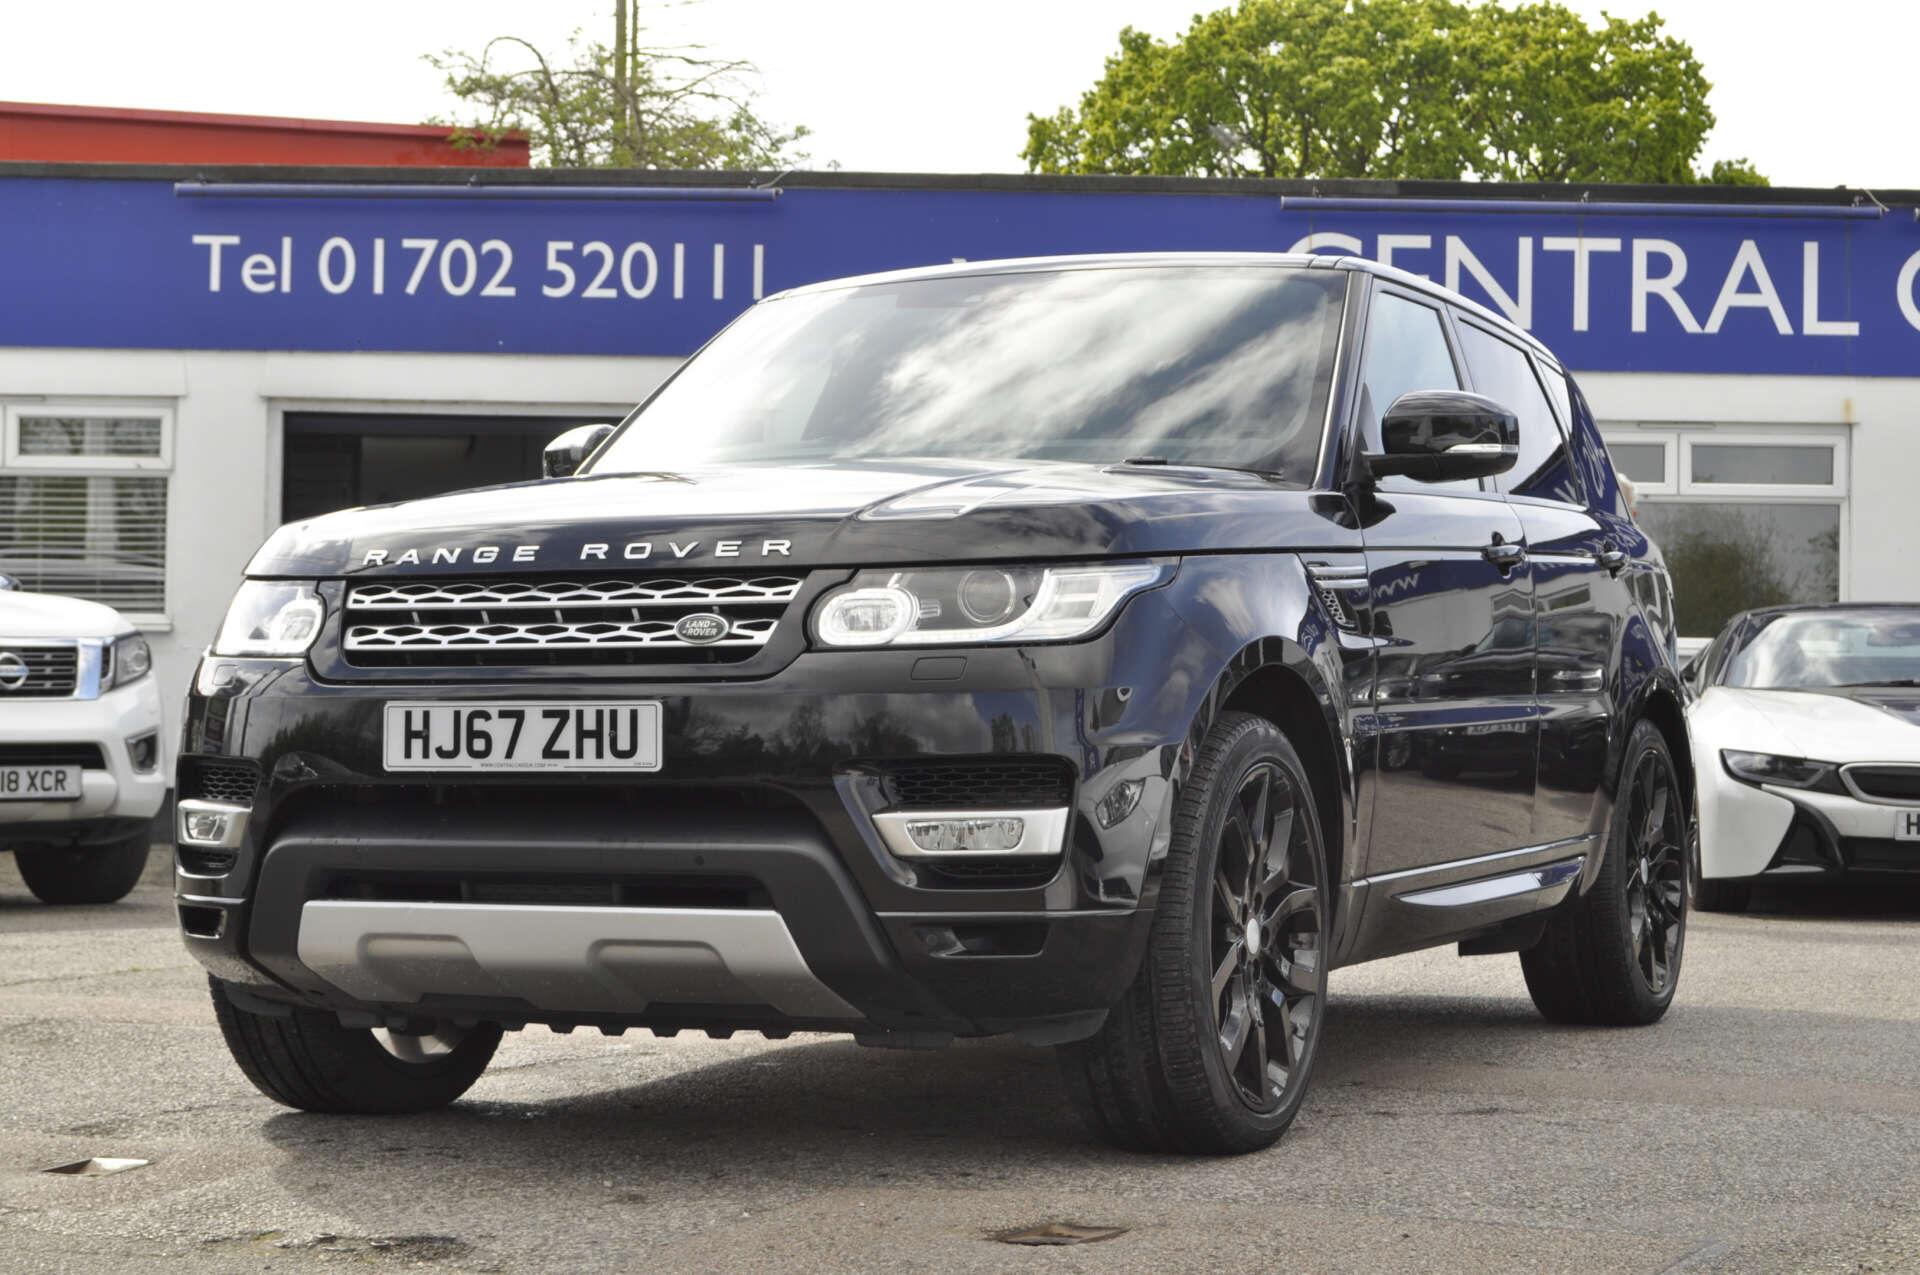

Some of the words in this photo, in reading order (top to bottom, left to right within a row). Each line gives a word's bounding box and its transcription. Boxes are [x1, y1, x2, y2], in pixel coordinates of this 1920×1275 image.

[192, 234, 292, 293] Tel
[317, 236, 516, 296] 01702
[542, 240, 764, 300] 520111
[1286, 231, 1860, 336] NTRAL
[362, 545, 540, 566] RANGE
[580, 539, 792, 561] ROVER
[403, 709, 525, 760] HJ67
[541, 708, 639, 760] ZHU
[27, 770, 66, 792] XCR
